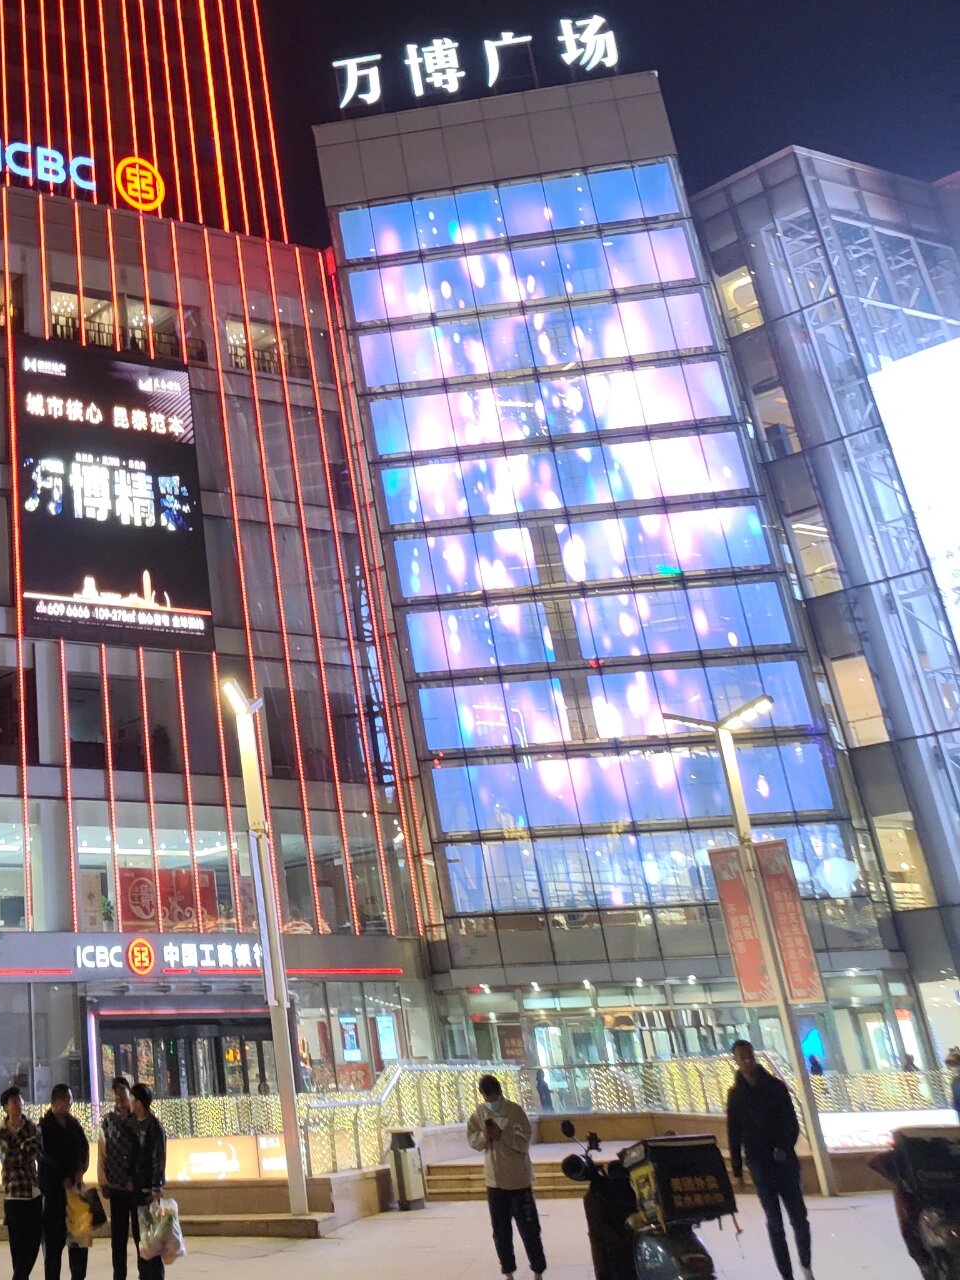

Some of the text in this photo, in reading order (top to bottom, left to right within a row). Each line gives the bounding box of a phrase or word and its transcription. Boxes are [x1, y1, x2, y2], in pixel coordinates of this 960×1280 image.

[332, 14, 619, 109] 万博广场
[26, 391, 103, 425] 城市核心
[76, 944, 123, 968] ICBC
